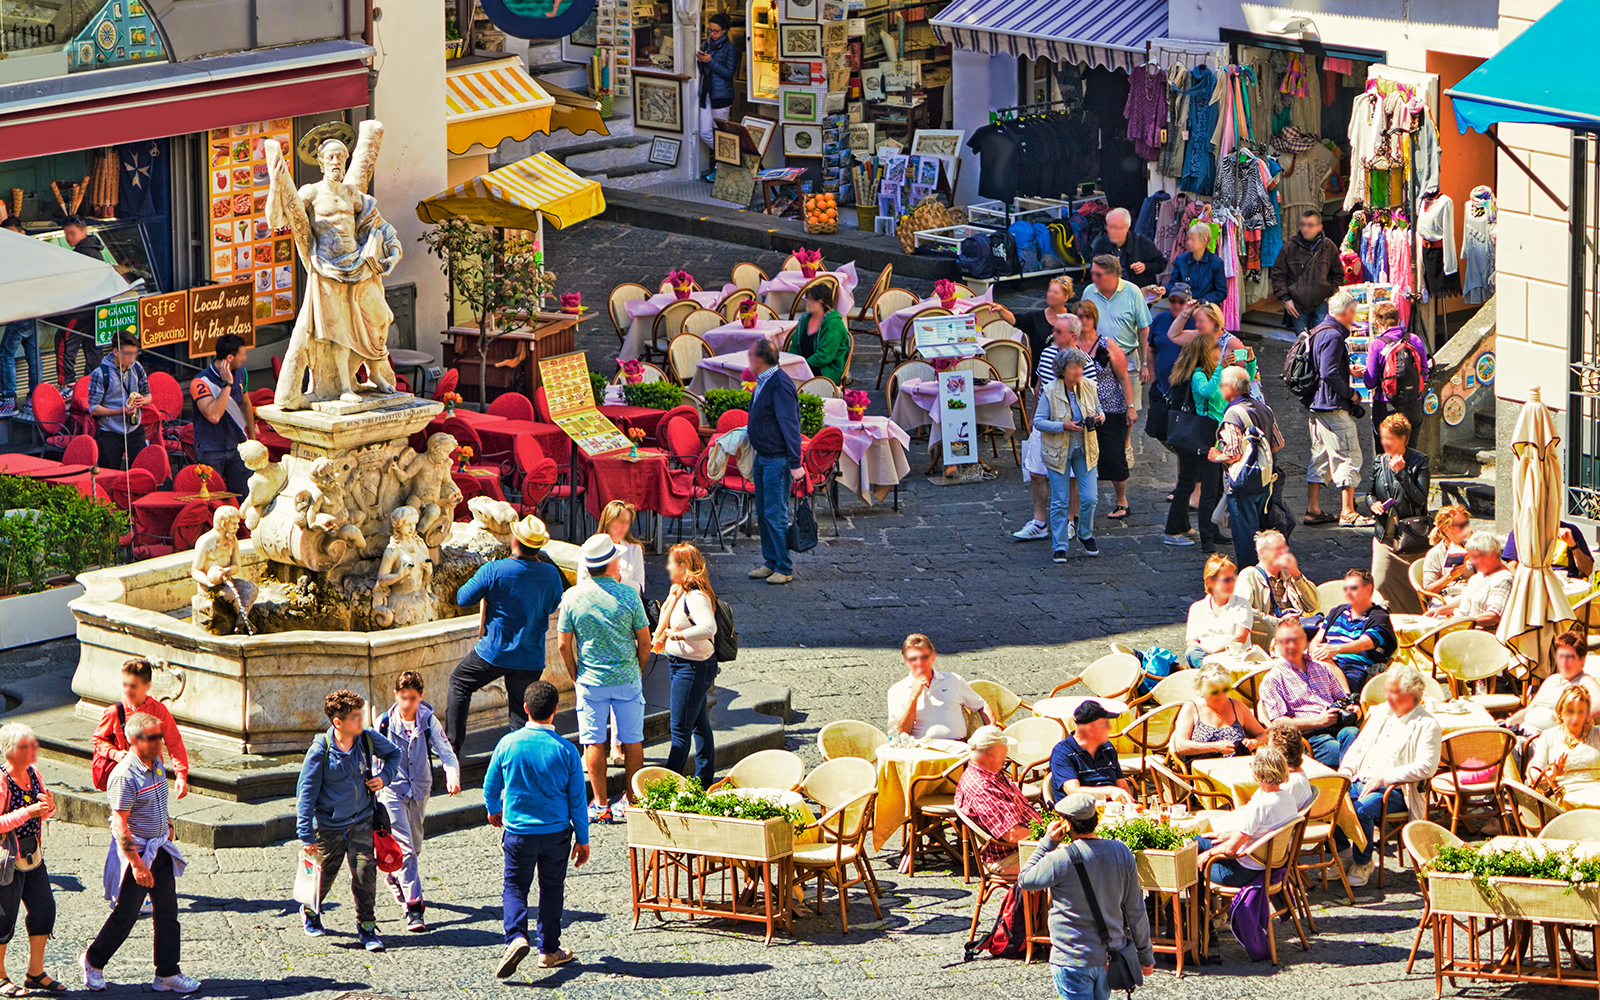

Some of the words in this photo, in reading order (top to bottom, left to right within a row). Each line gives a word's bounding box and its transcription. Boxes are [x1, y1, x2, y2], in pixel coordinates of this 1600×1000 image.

[194, 290, 225, 313] Local
[226, 289, 250, 308] wine
[108, 304, 137, 317] GRANITA
[99, 320, 107, 329] DI
[109, 315, 136, 327] LIMONE
[157, 316, 165, 326] e
[143, 327, 185, 345] Cappuccino
[193, 321, 207, 349] by
[208, 318, 225, 338] the
[196, 383, 207, 395] 2
